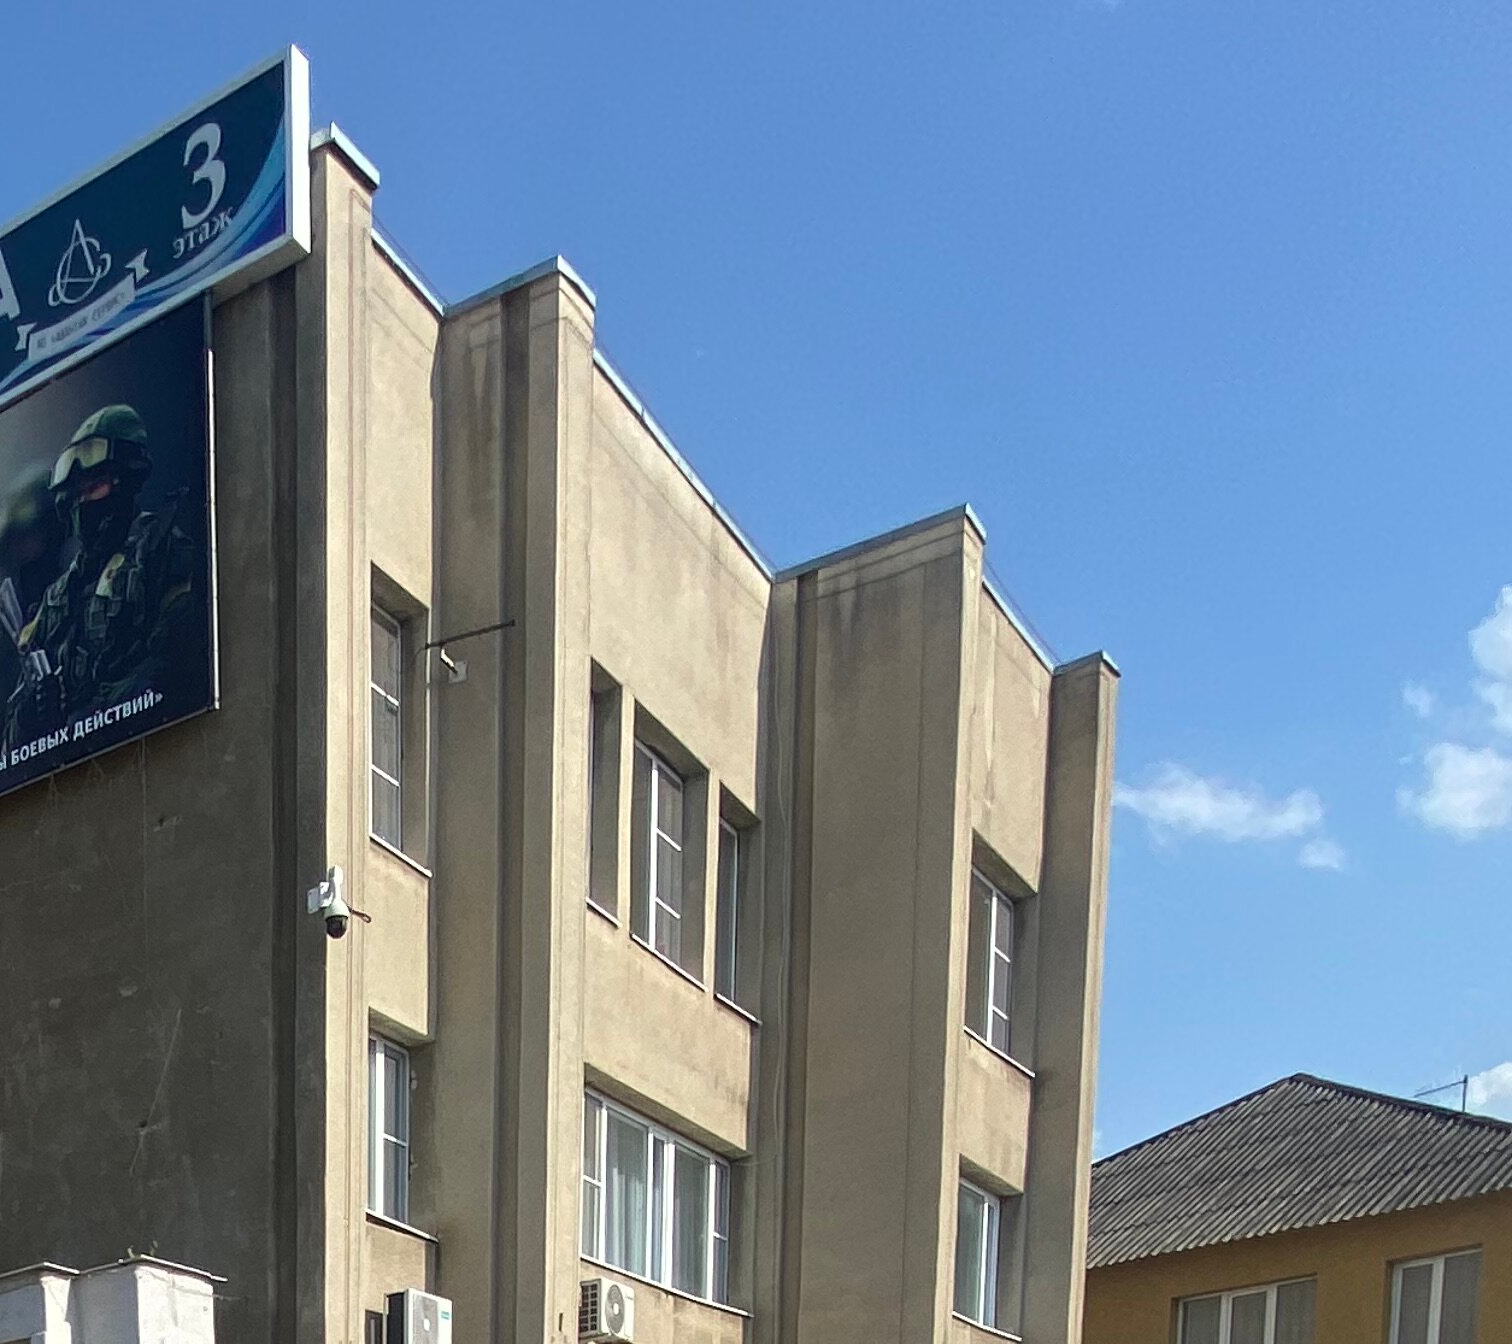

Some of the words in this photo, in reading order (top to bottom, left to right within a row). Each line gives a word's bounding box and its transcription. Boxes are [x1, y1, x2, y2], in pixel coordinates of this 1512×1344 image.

[182, 123, 226, 229] 3
[172, 206, 235, 259] этаж
[10, 730, 70, 766] БОЕВЫХ
[72, 691, 165, 742] ДЕЙСТВИЙ»
